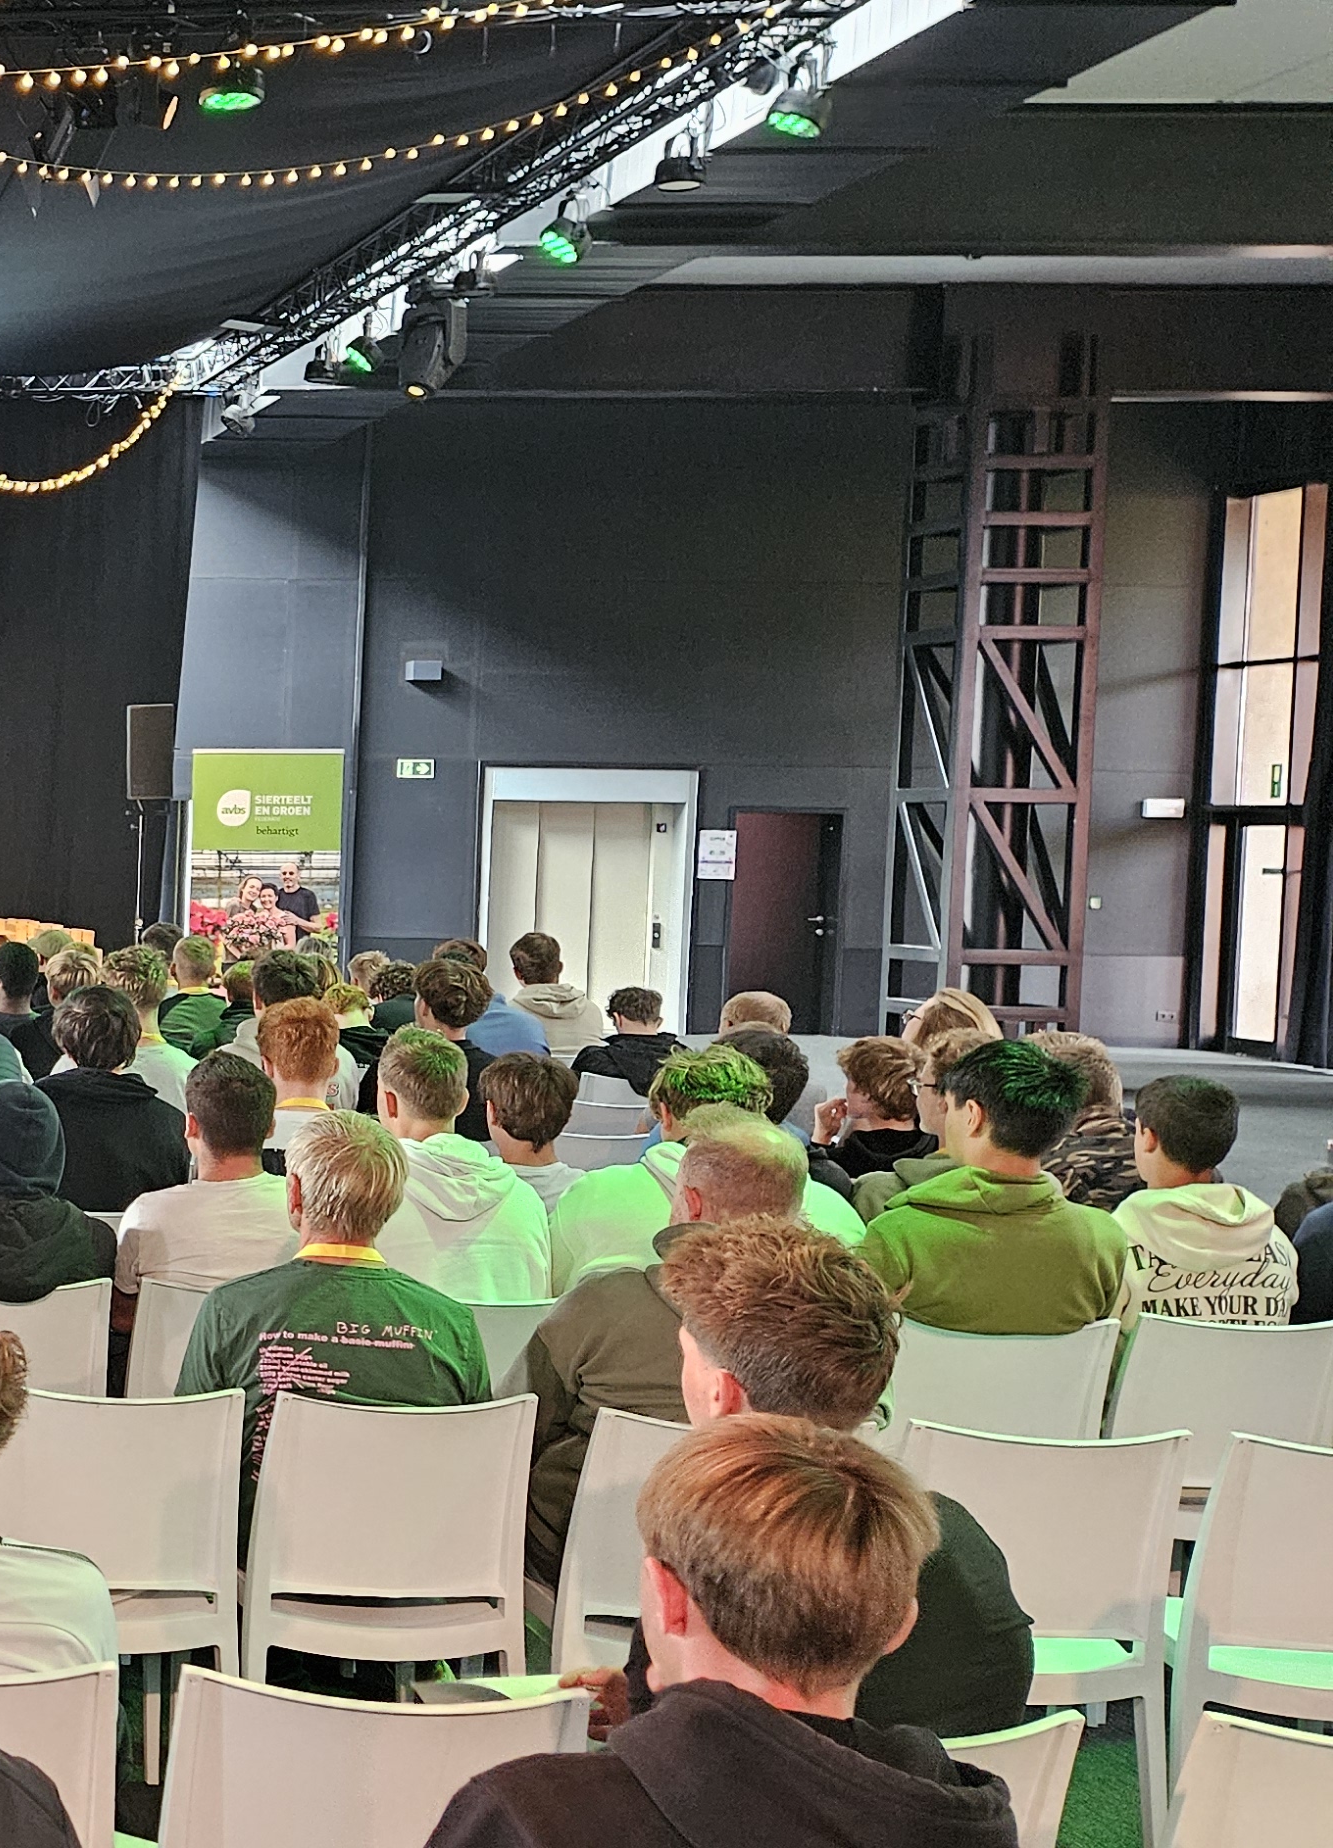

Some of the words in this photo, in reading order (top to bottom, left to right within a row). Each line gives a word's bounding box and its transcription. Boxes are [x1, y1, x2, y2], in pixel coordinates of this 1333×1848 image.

[254, 795, 313, 805] SIERTEELT
[221, 804, 247, 815] avbs
[254, 805, 271, 816] EN
[272, 805, 311, 816] GROEN
[256, 826, 299, 837] behartigt
[1147, 1257, 1293, 1301] Everyday
[1141, 1296, 1203, 1318] MAKE
[1203, 1295, 1259, 1316] YOUR
[336, 1321, 371, 1335] BIG
[258, 1332, 282, 1342] How
[283, 1330, 295, 1340] to
[297, 1332, 329, 1343] make
[331, 1336, 339, 1344] a
